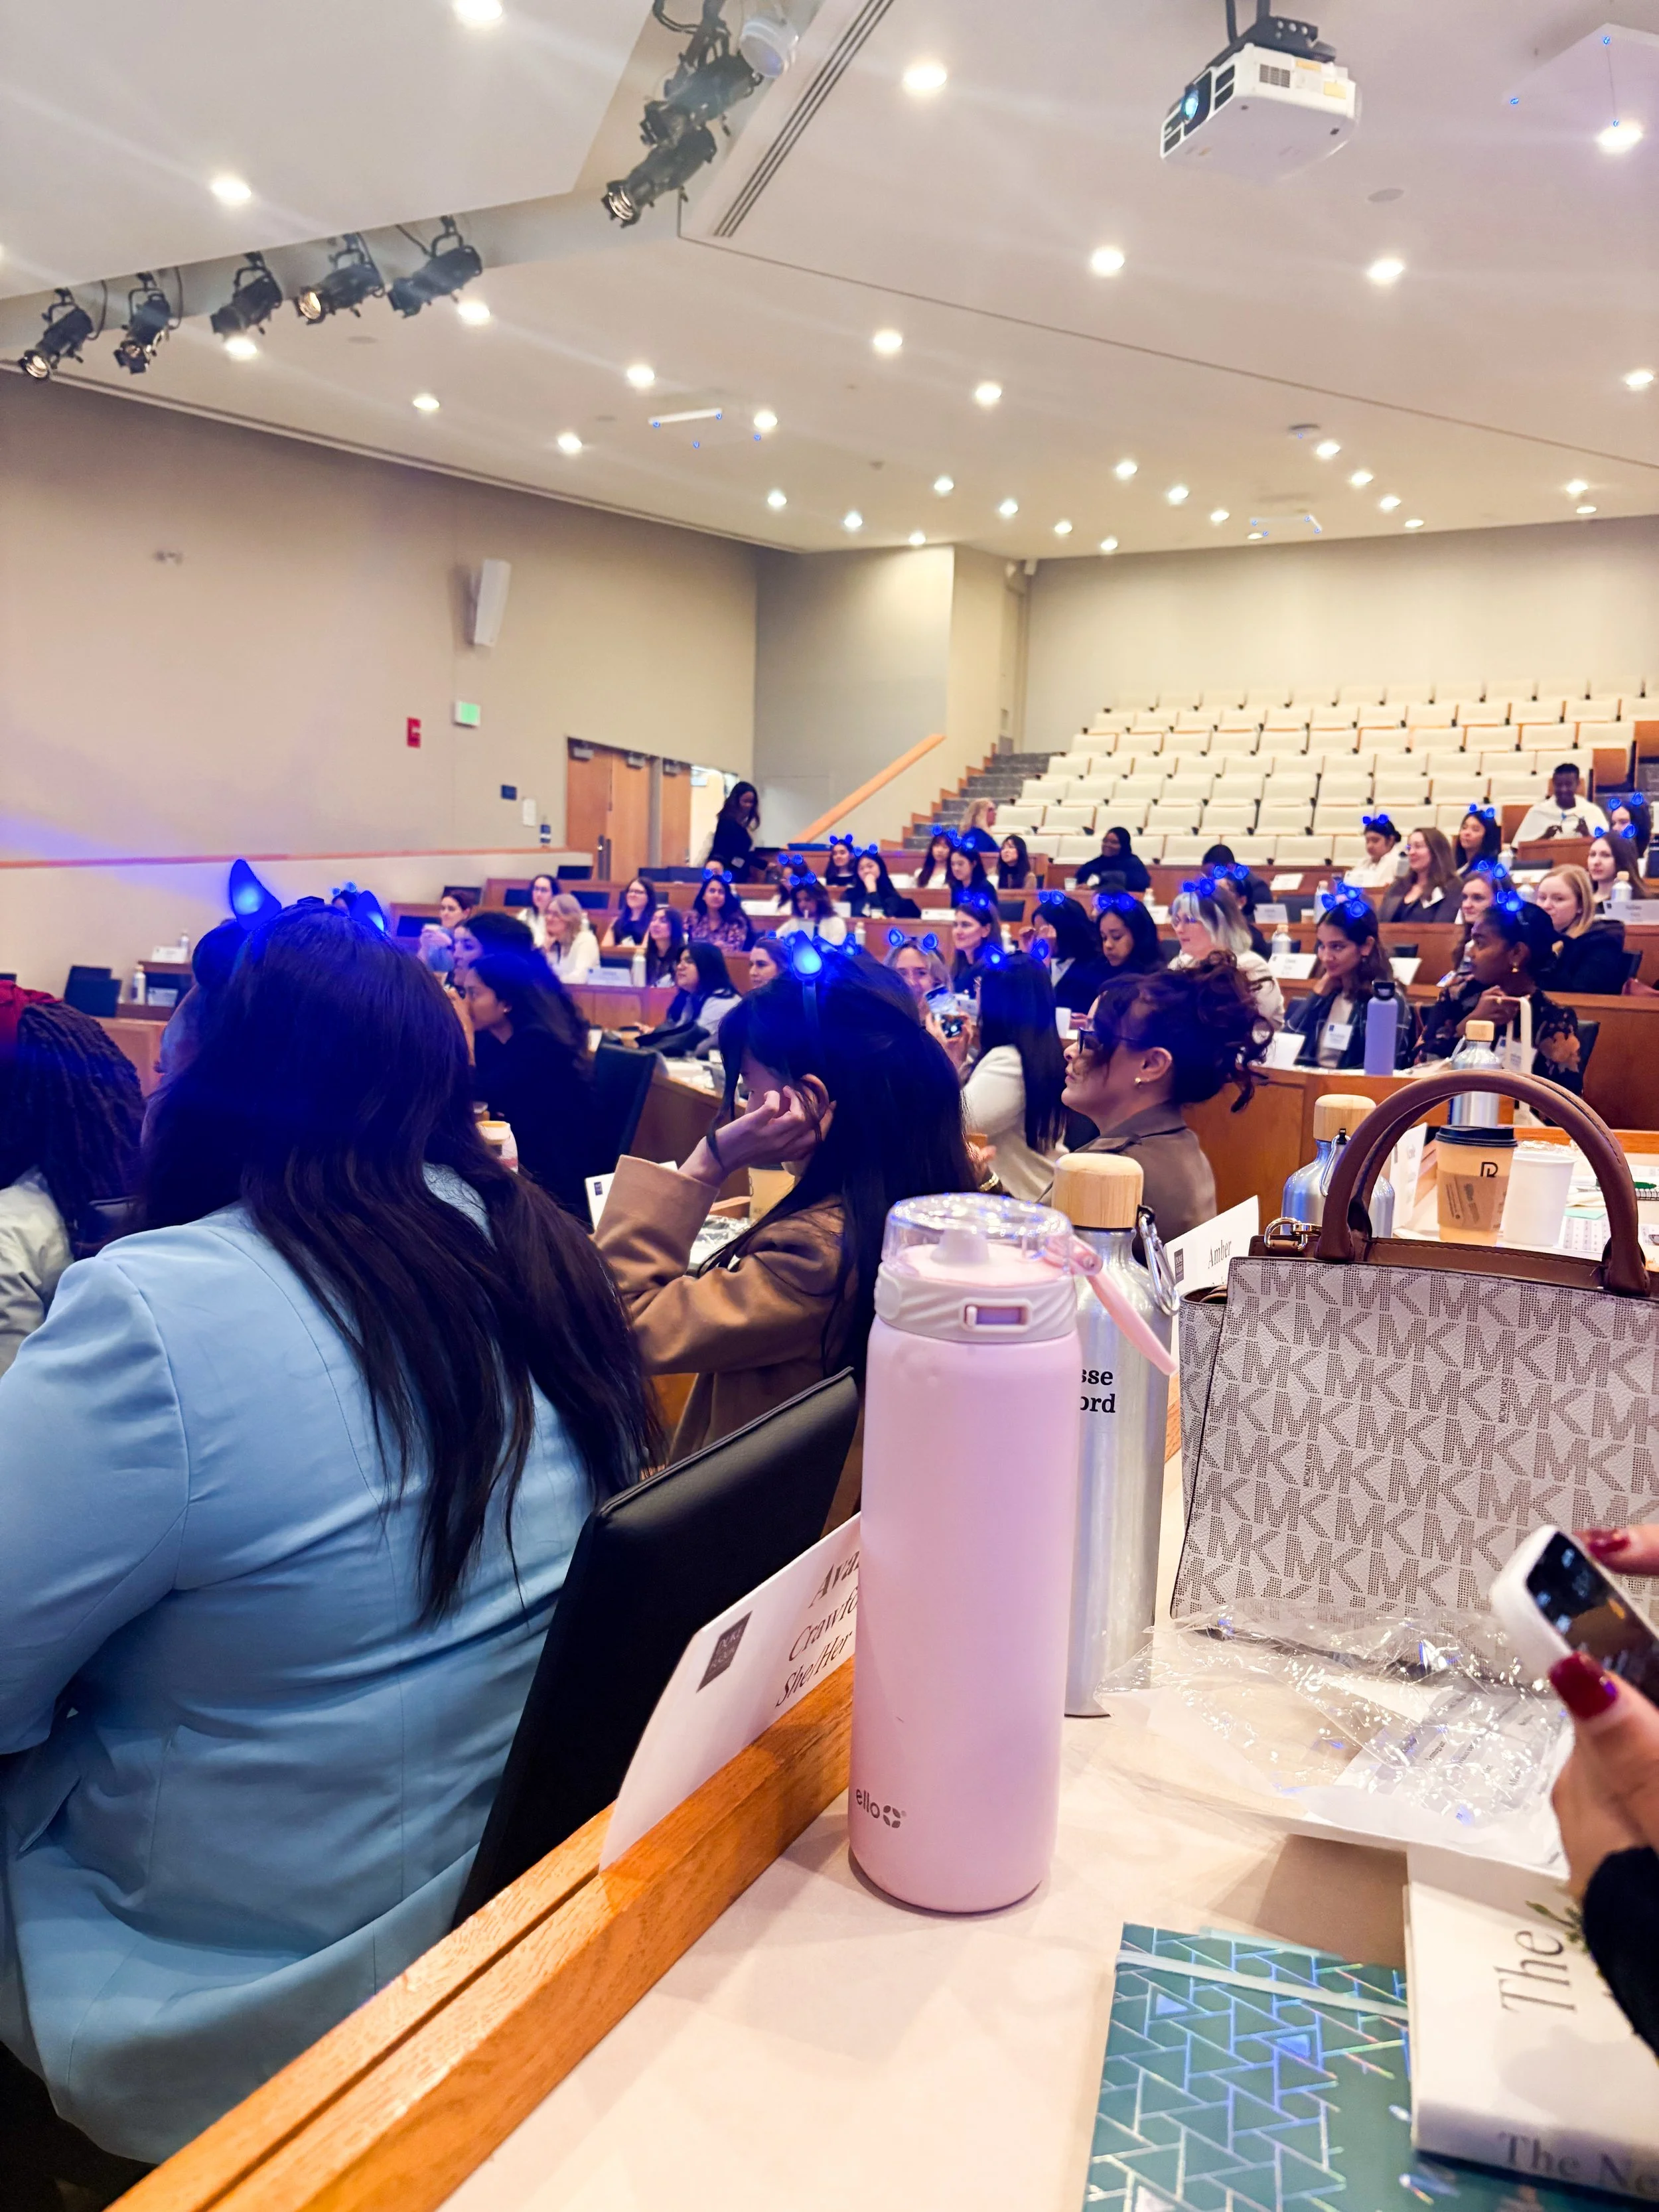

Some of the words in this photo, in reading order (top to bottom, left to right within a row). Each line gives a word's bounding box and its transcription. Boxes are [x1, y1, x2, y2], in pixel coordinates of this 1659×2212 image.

[1208, 1239, 1232, 1270] Amber
[1261, 1259, 1338, 1305] MK
[1342, 1264, 1424, 1316] MK
[1429, 1274, 1513, 1327] MK
[1518, 1284, 1608, 1339] MK
[1613, 1297, 1659, 1347] M
[1242, 1341, 1322, 1394] MK
[1324, 1352, 1407, 1408] MK
[1409, 1364, 1494, 1422] MK
[1503, 1378, 1588, 1435] MK
[1293, 1302, 1372, 1355] MK
[1376, 1313, 1459, 1368] MK
[1463, 1324, 1551, 1380] MK
[1554, 1337, 1648, 1394] MK
[1500, 1377, 1509, 1394] KORS
[1271, 1391, 1353, 1446] MK
[1356, 1404, 1439, 1461] MK
[1443, 1418, 1528, 1476] MK
[1534, 1432, 1626, 1493] MK
[1498, 1396, 1508, 1423] MICHAEL
[1223, 1429, 1299, 1485] MK
[1307, 1443, 1385, 1501] MK
[1388, 1458, 1473, 1516] MK
[1477, 1472, 1567, 1525] MK
[1303, 1461, 1313, 1487] MICHAEL
[1206, 1515, 1281, 1574] MK
[1283, 1534, 1364, 1593] MK
[1367, 1550, 1453, 1605] MK
[1254, 1481, 1330, 1538] MK
[1334, 1496, 1418, 1555] MK
[1421, 1512, 1509, 1572] MK
[774, 1631, 853, 1709] She/Her
[856, 1789, 881, 1819] ello
[1493, 1930, 1577, 2016] The
[1497, 2131, 1581, 2178] The
